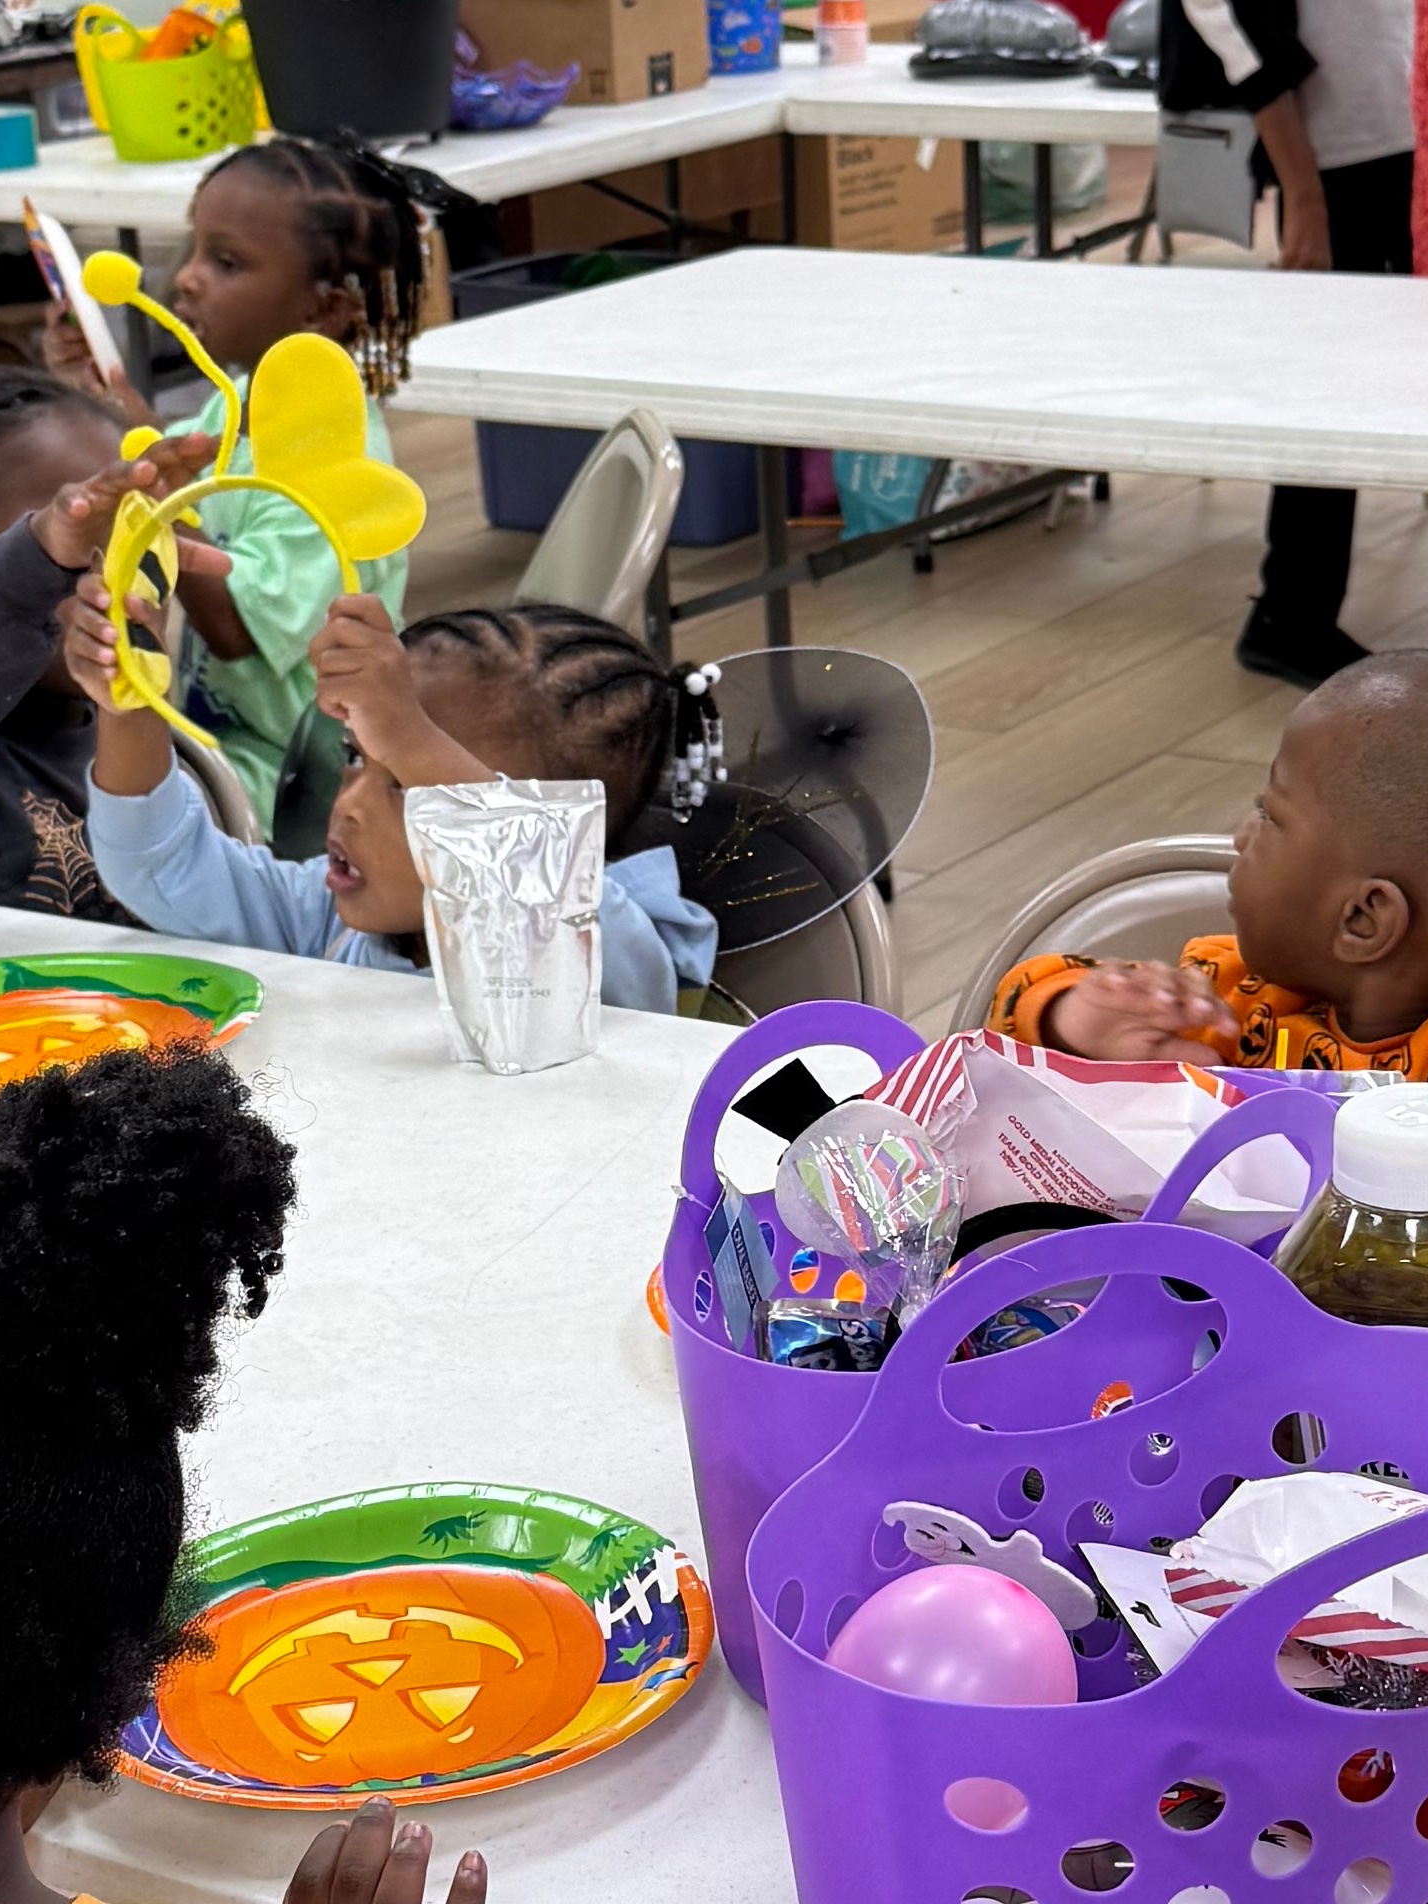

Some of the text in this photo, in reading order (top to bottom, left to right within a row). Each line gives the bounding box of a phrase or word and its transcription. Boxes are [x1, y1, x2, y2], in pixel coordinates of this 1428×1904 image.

[1008, 1114, 1031, 1140] GOLD
[998, 1132, 1067, 1204] TEAM GOLD MEDA
